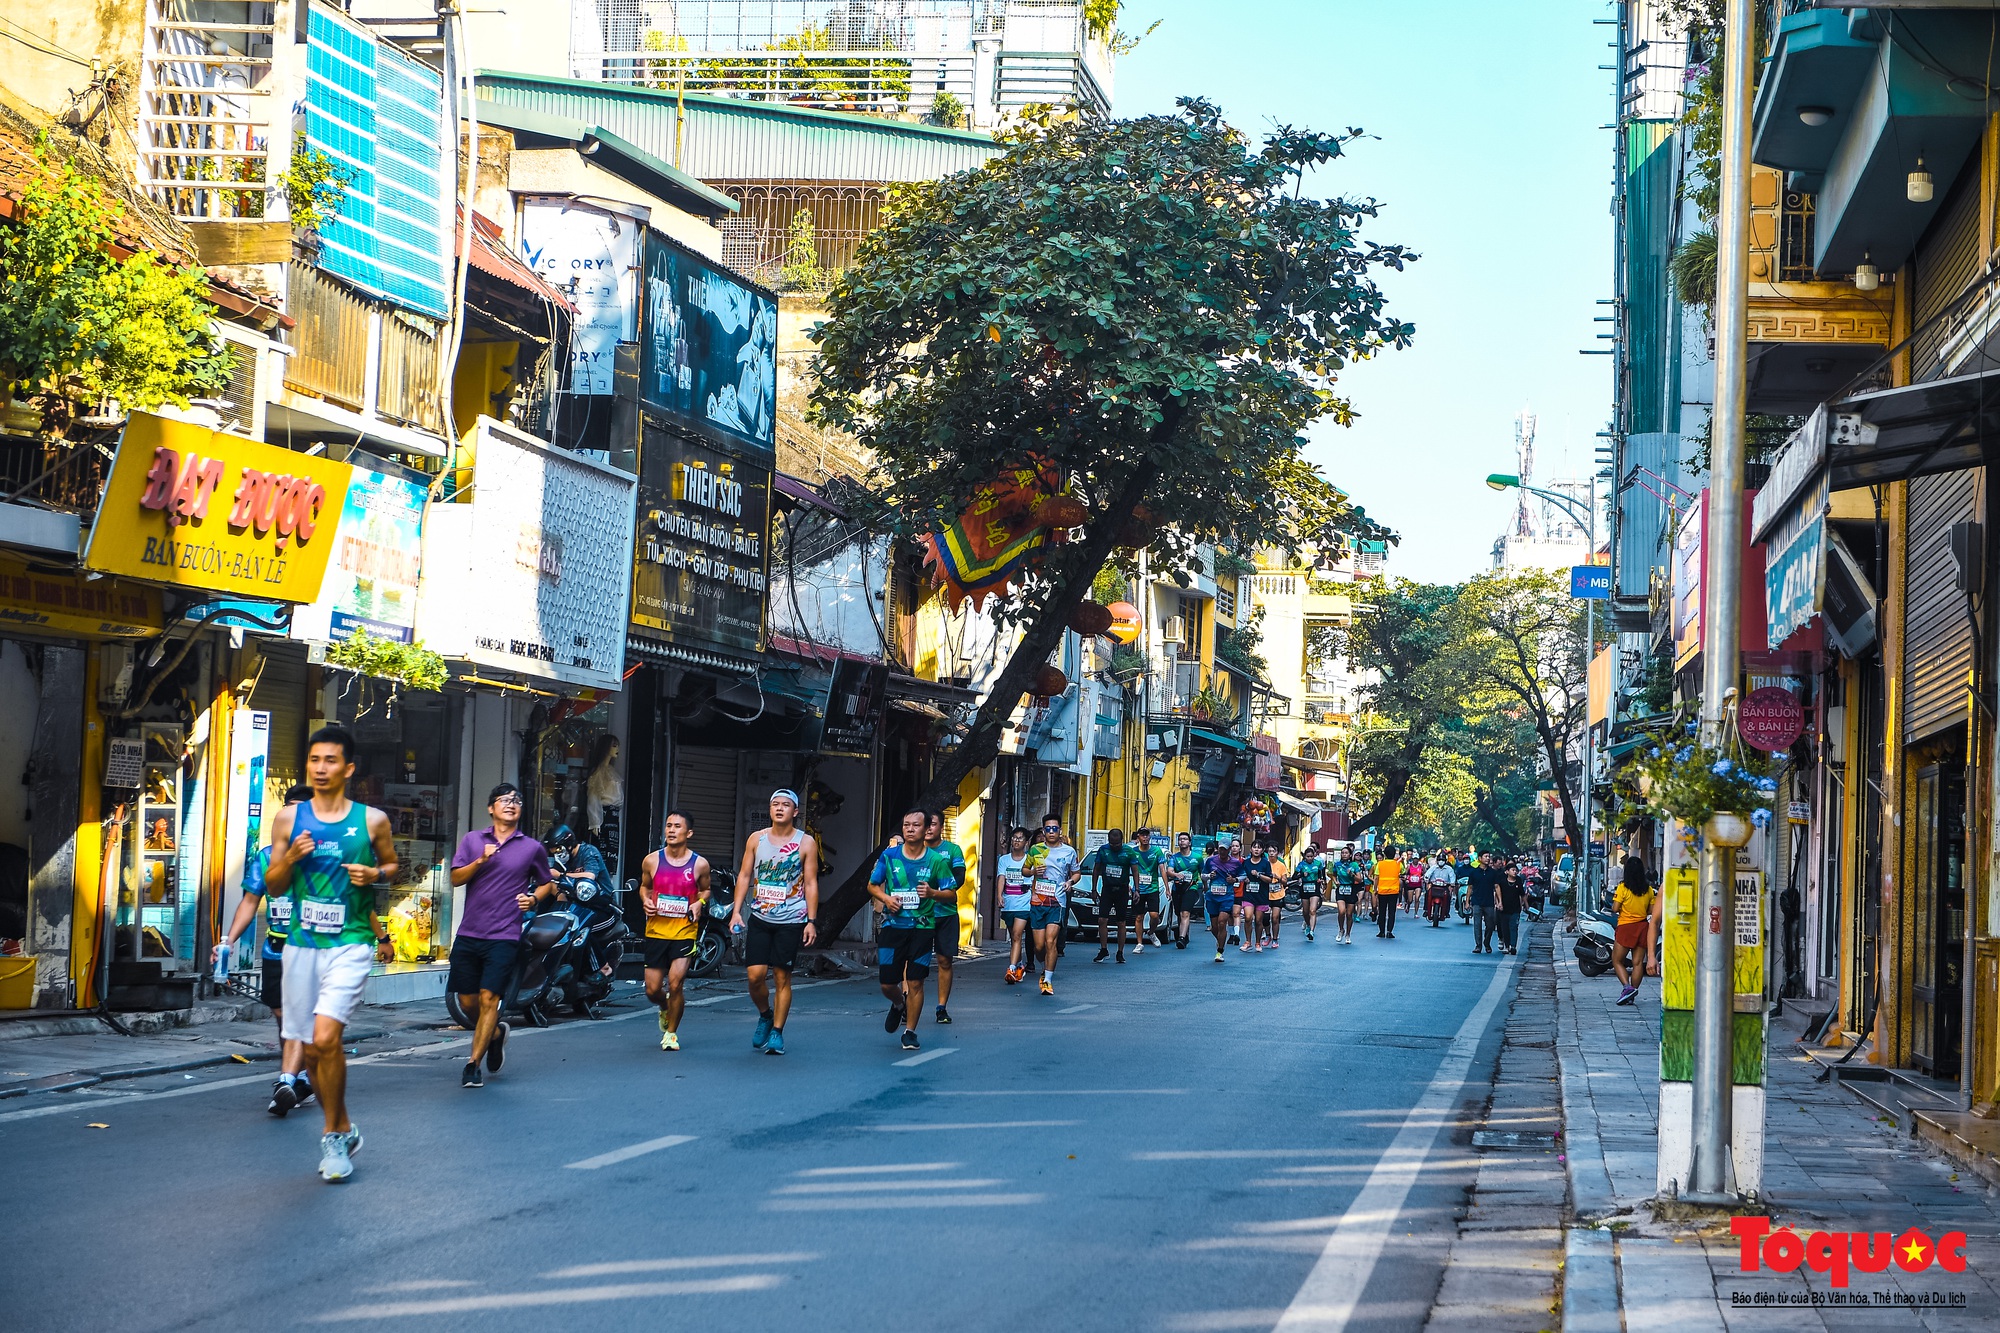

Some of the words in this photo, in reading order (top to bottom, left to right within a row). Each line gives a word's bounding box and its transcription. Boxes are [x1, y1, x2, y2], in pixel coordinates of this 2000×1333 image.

[683, 462, 717, 509] THIÊN
[719, 466, 742, 518] SẮC
[140, 446, 225, 527] ĐẠT
[227, 466, 326, 549] ĐƯỢC
[657, 510, 690, 538] CHUYÊN
[691, 515, 708, 541] BÁN
[709, 525, 731, 550] BUÔN
[735, 529, 752, 555] BÁN
[141, 532, 182, 567] BÁN
[180, 540, 228, 575] BUÔN
[230, 549, 262, 580] BÁN
[264, 551, 288, 584] LẺ
[646, 535, 660, 562] TÚI
[662, 541, 686, 570] XÁCH
[693, 551, 713, 577] GIÀY
[714, 556, 729, 581] DÉP
[1590, 577, 1609, 589] MB
[1742, 705, 1765, 717] BÁN
[1768, 705, 1799, 718] BUÔN
[1747, 721, 1755, 731] &
[1759, 720, 1781, 731] BÁN
[1784, 719, 1795, 731] LẺ
[128, 744, 142, 757] NHÀ
[1735, 877, 1757, 895] NHÀ
[767, 889, 784, 898] 95028
[315, 910, 340, 921] 10401
[1738, 935, 1757, 945] 1945
